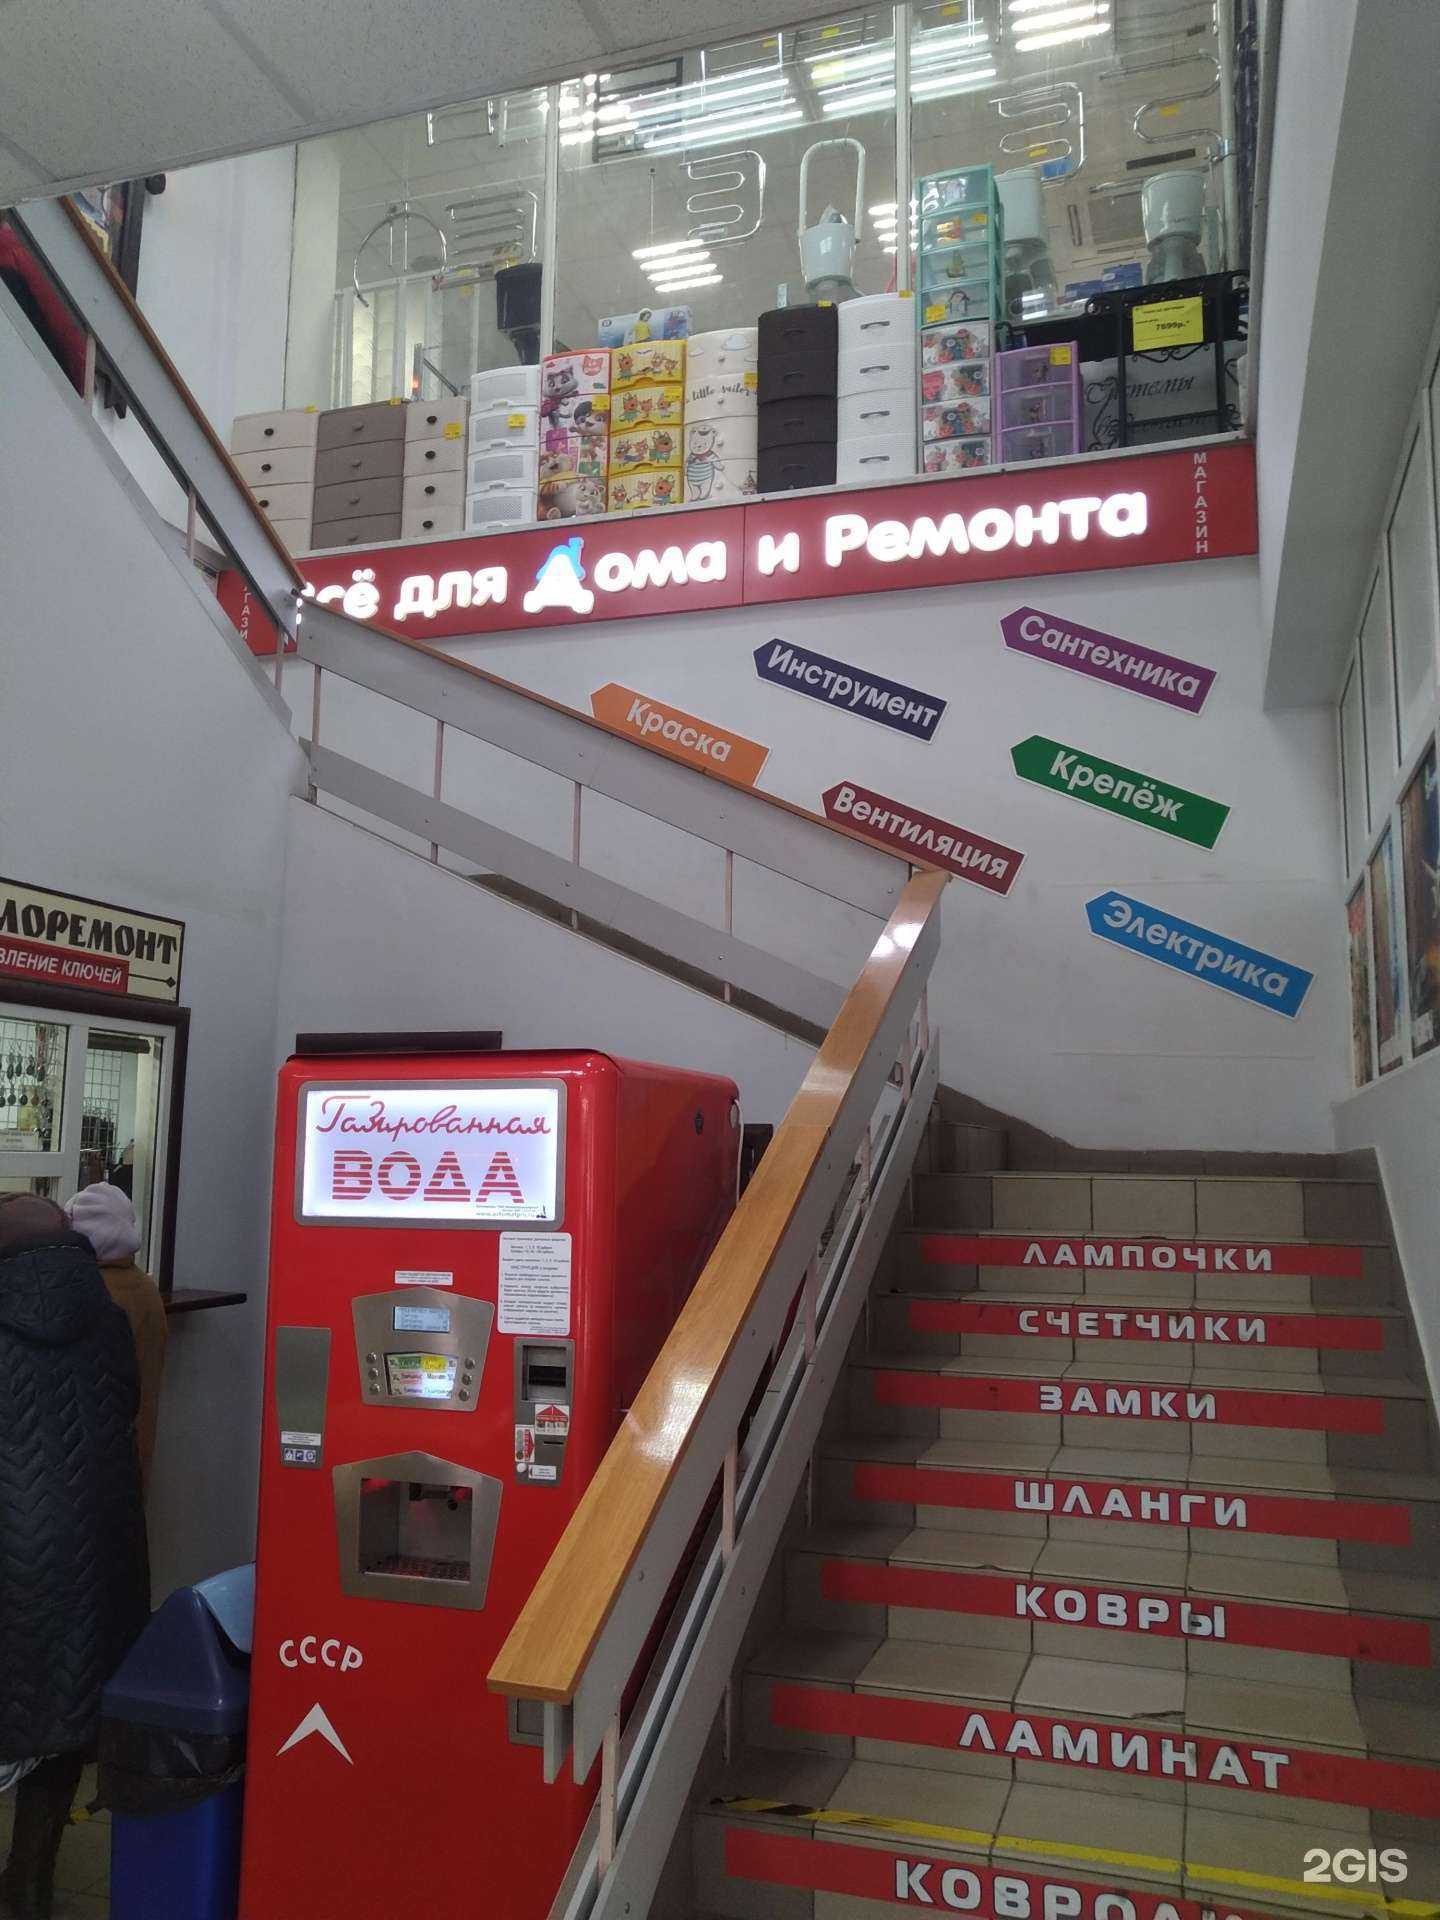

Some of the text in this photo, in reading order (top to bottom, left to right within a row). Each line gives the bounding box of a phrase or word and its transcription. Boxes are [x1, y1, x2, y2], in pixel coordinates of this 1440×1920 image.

[1193, 451, 1209, 555] МАГАЗИН
[394, 566, 508, 622] для
[523, 537, 727, 614] Дома
[758, 532, 800, 576] и
[825, 492, 1148, 567] Ремонта
[767, 644, 938, 728] Инструмент
[1019, 615, 1201, 699] Сантехника
[626, 697, 732, 763] Краска
[1050, 750, 1185, 823] Крепёж
[833, 786, 1010, 880] Вентиляция
[61, 960, 122, 985] КЛЮЧЕЙ
[1103, 900, 1290, 998] Электрика
[316, 1095, 551, 1142] Газированная
[332, 1150, 525, 1203] ВОДА
[1023, 1243, 1273, 1272] ЛАМПОЧКИ
[1019, 1310, 1266, 1343] СЧЕТЧИКИ
[1039, 1385, 1217, 1420] ЗАМКИ
[1014, 1481, 1248, 1528] ШЛАНГИ
[1015, 1584, 1227, 1638] КОВРЫ
[279, 1635, 363, 1672] СССР
[959, 1713, 1290, 1790] ЛАМИНАТ
